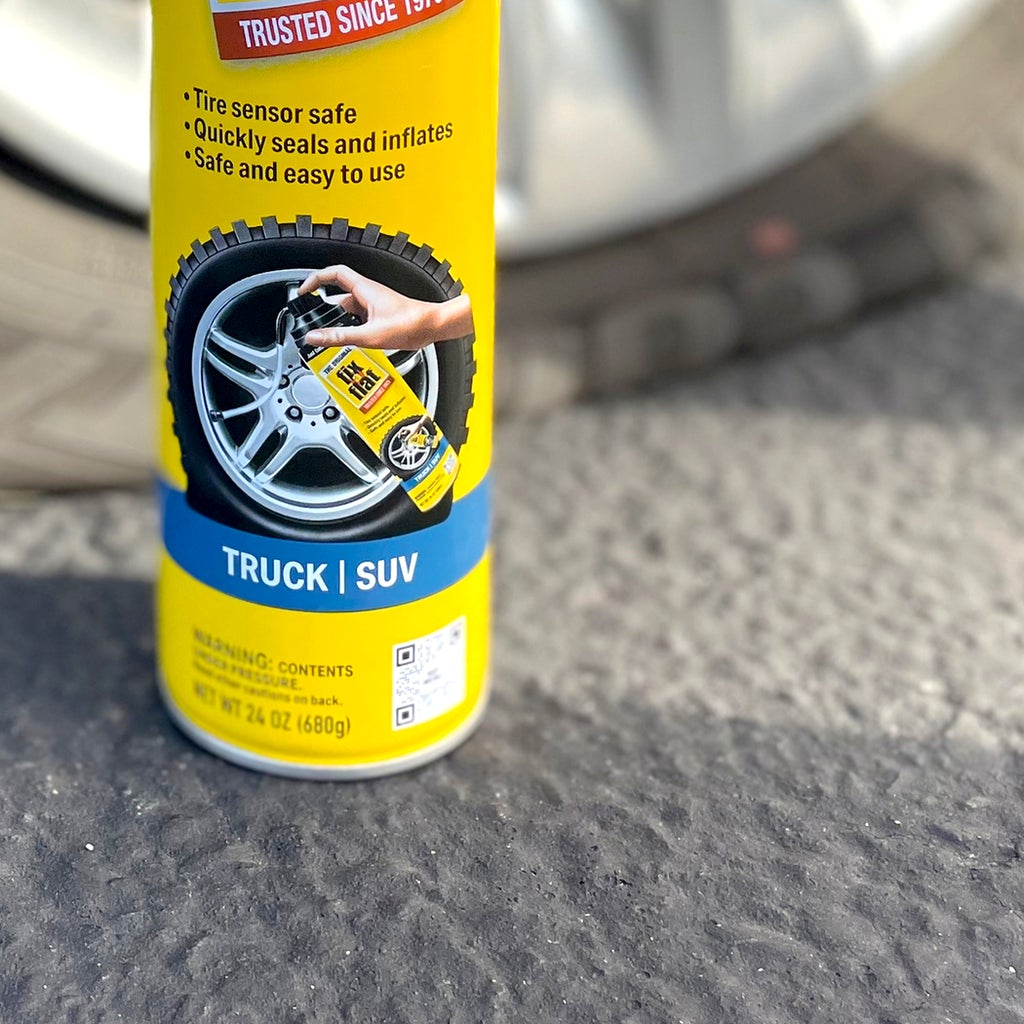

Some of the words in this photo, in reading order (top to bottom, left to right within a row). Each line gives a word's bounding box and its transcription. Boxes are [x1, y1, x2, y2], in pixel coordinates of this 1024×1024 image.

[239, 13, 331, 48] TRUSTED
[192, 87, 227, 115] Tire
[231, 100, 303, 124] sensor
[309, 103, 357, 125] safe
[194, 117, 266, 156] Quickly
[271, 133, 329, 155] seals
[335, 132, 376, 154] and
[382, 122, 453, 151] inflates
[194, 147, 234, 175] Safe
[239, 158, 277, 182] and
[284, 165, 334, 190] easy
[341, 164, 363, 184] to
[370, 161, 405, 182] use
[336, 360, 364, 385] fix
[348, 369, 381, 401] flat
[222, 545, 329, 592] TRUCK
[356, 552, 419, 591] SUV
[278, 661, 354, 677] CONTENTS
[311, 695, 343, 706] back.
[246, 704, 266, 725] 24
[270, 710, 292, 731] OZ
[297, 715, 351, 739] (680g)
